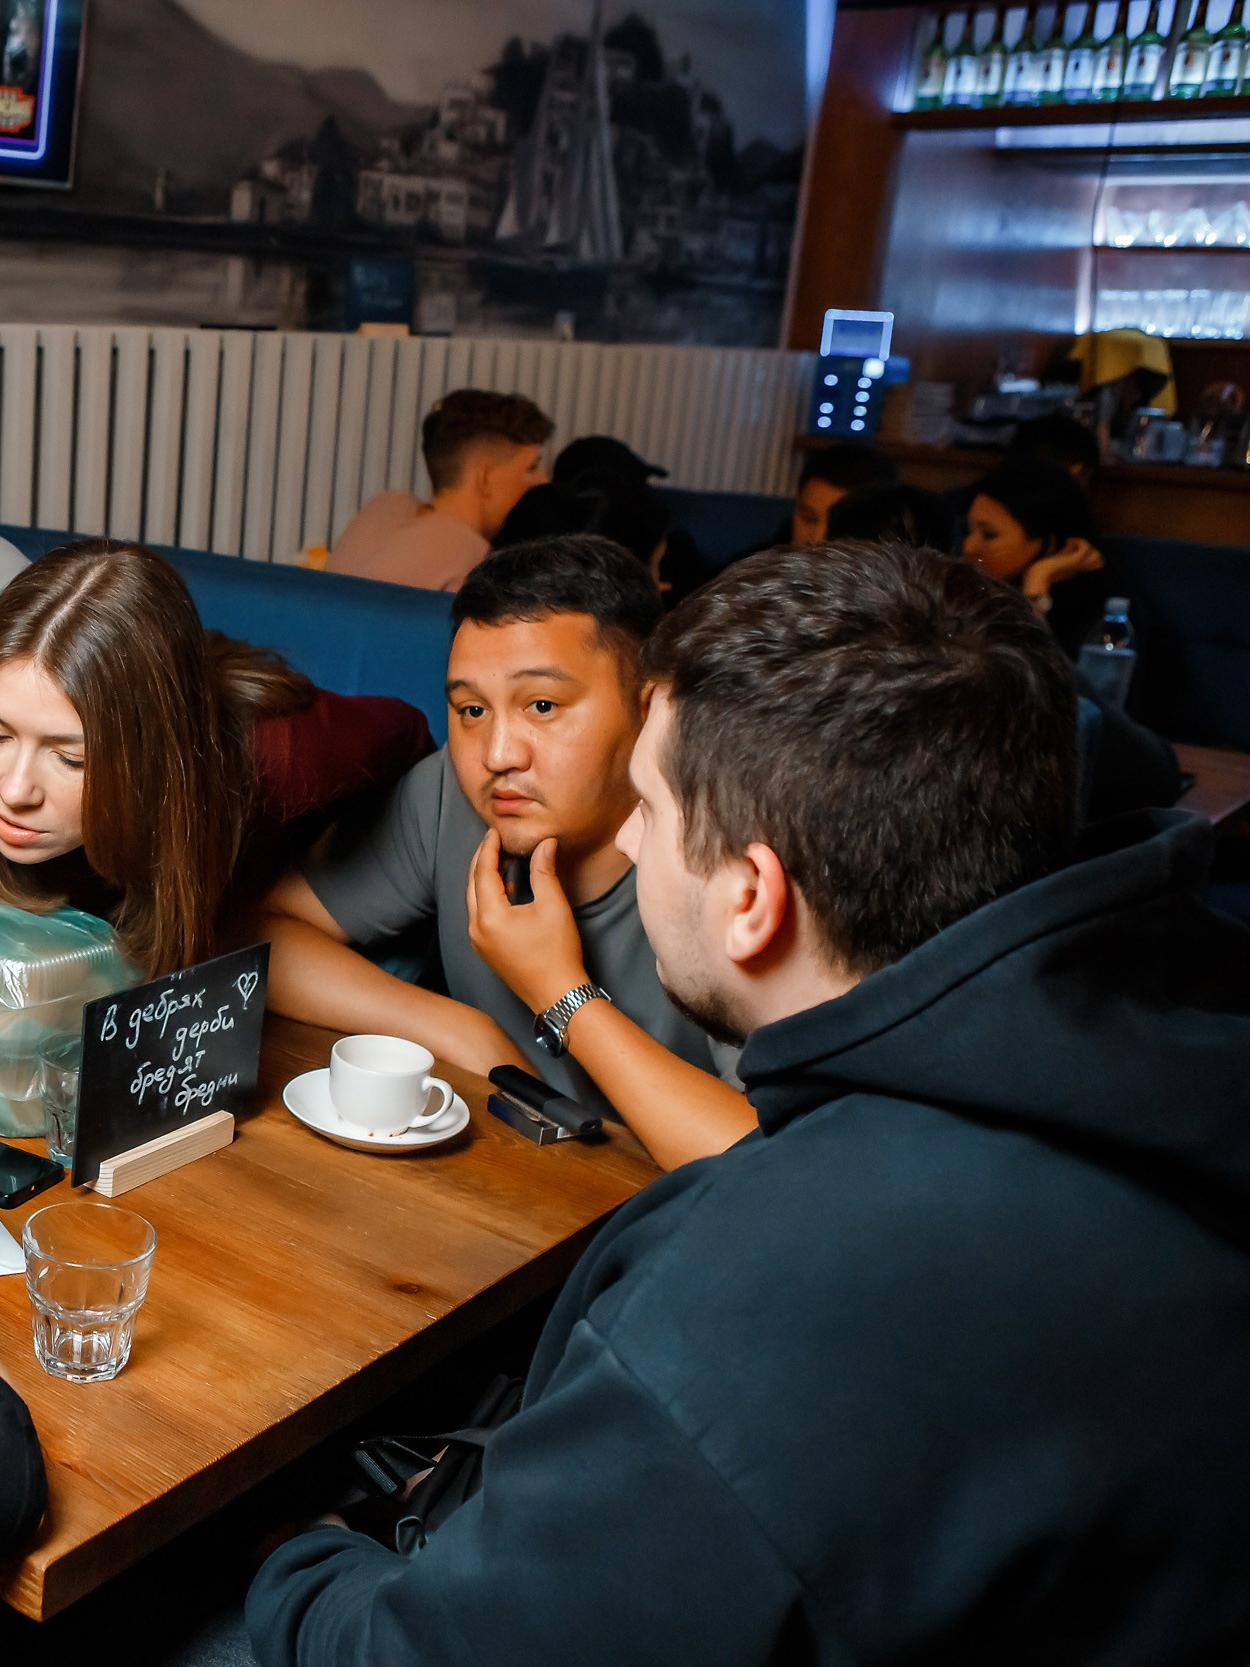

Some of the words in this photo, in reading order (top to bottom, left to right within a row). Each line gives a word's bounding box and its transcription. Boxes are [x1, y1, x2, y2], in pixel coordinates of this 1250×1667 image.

[100, 1003, 119, 1042] В
[125, 988, 207, 1050] дебрях
[172, 1004, 236, 1062] дерби
[130, 1049, 207, 1106] бредят
[174, 1071, 239, 1116] бредни
